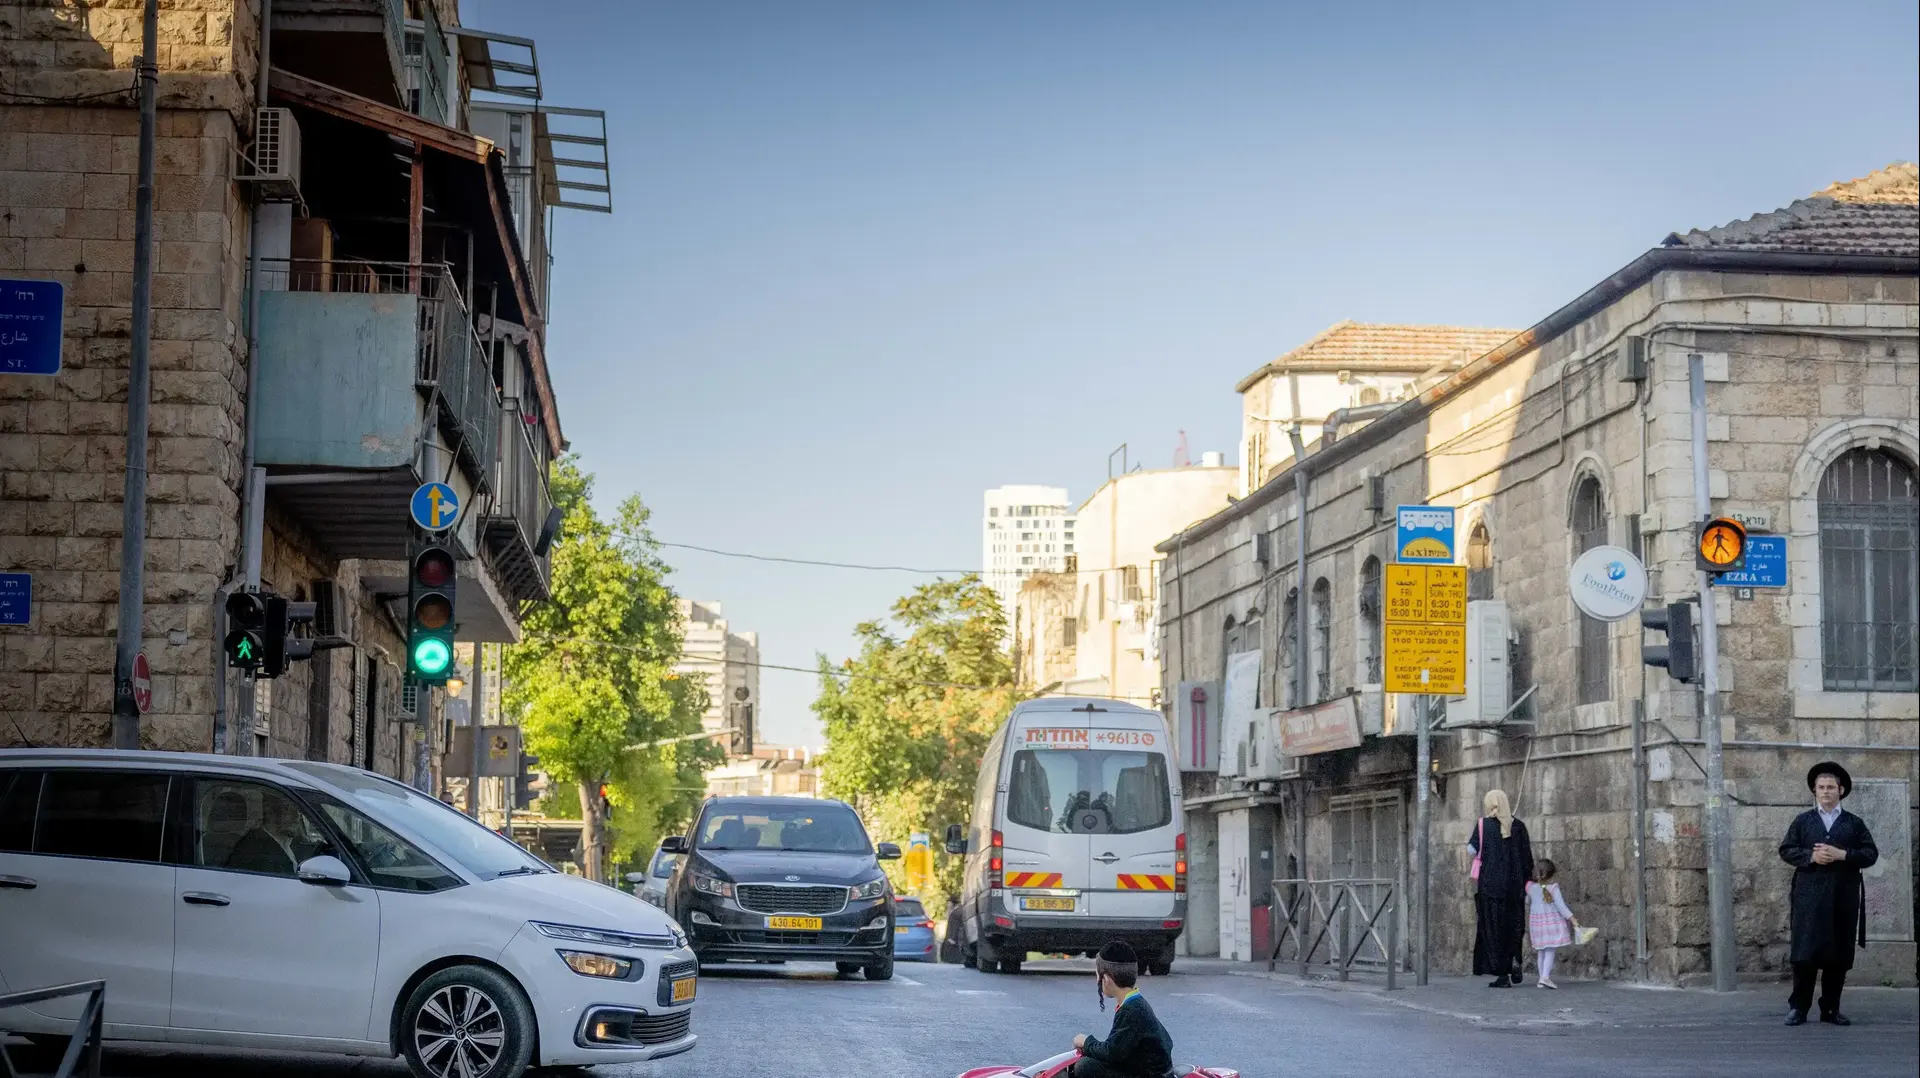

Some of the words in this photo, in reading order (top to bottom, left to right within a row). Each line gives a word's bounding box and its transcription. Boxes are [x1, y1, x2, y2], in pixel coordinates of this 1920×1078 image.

[1, 330, 28, 346] شارع
[7, 359, 27, 368] ST.
[1726, 573, 1758, 582] EZRA
[1583, 573, 1635, 602] FootPrint
[1400, 588, 1412, 596] FRI
[1738, 588, 1751, 598] 13
[1391, 599, 1410, 607] 6:30
[1431, 600, 1450, 608] 6:30
[4, 612, 16, 620] ST.
[1390, 608, 1410, 616] 15:00
[1429, 610, 1450, 618] 20:00
[1026, 728, 1089, 742] אחדות
